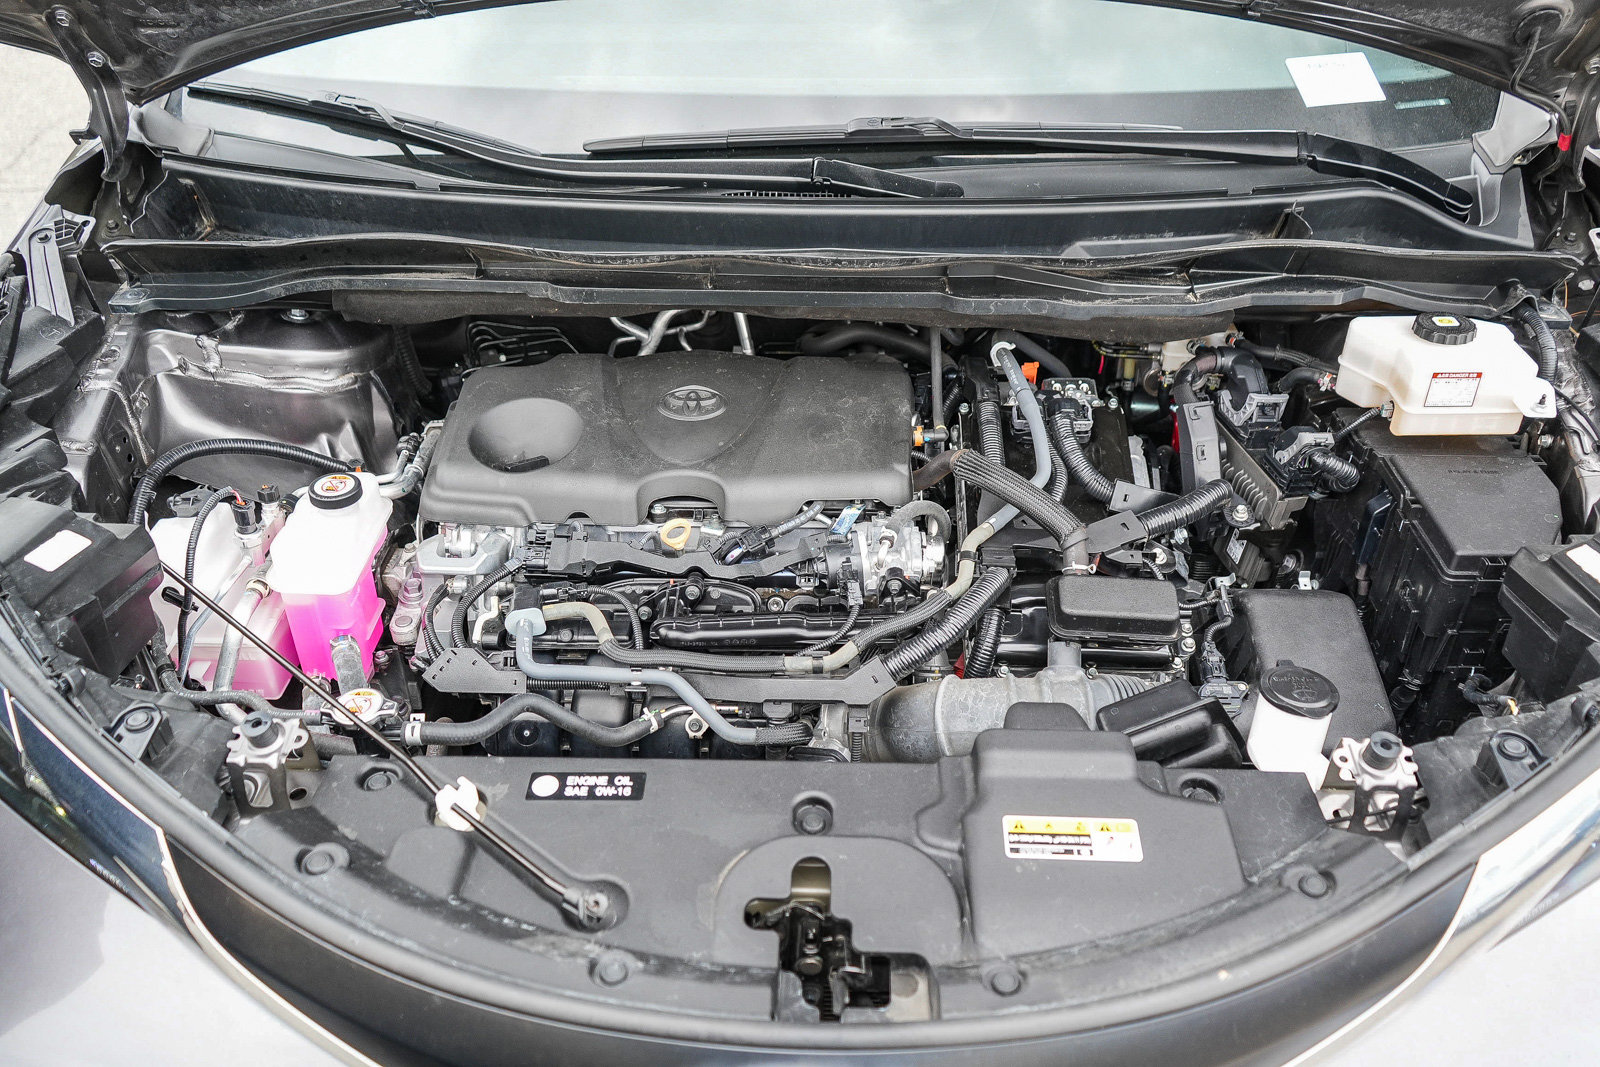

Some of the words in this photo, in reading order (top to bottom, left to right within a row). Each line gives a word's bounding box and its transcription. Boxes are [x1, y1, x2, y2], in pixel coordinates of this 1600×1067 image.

[566, 775, 609, 786] ENGINE
[614, 775, 633, 786] OIL
[564, 786, 589, 797] SAE
[595, 786, 632, 797] 0W-16
